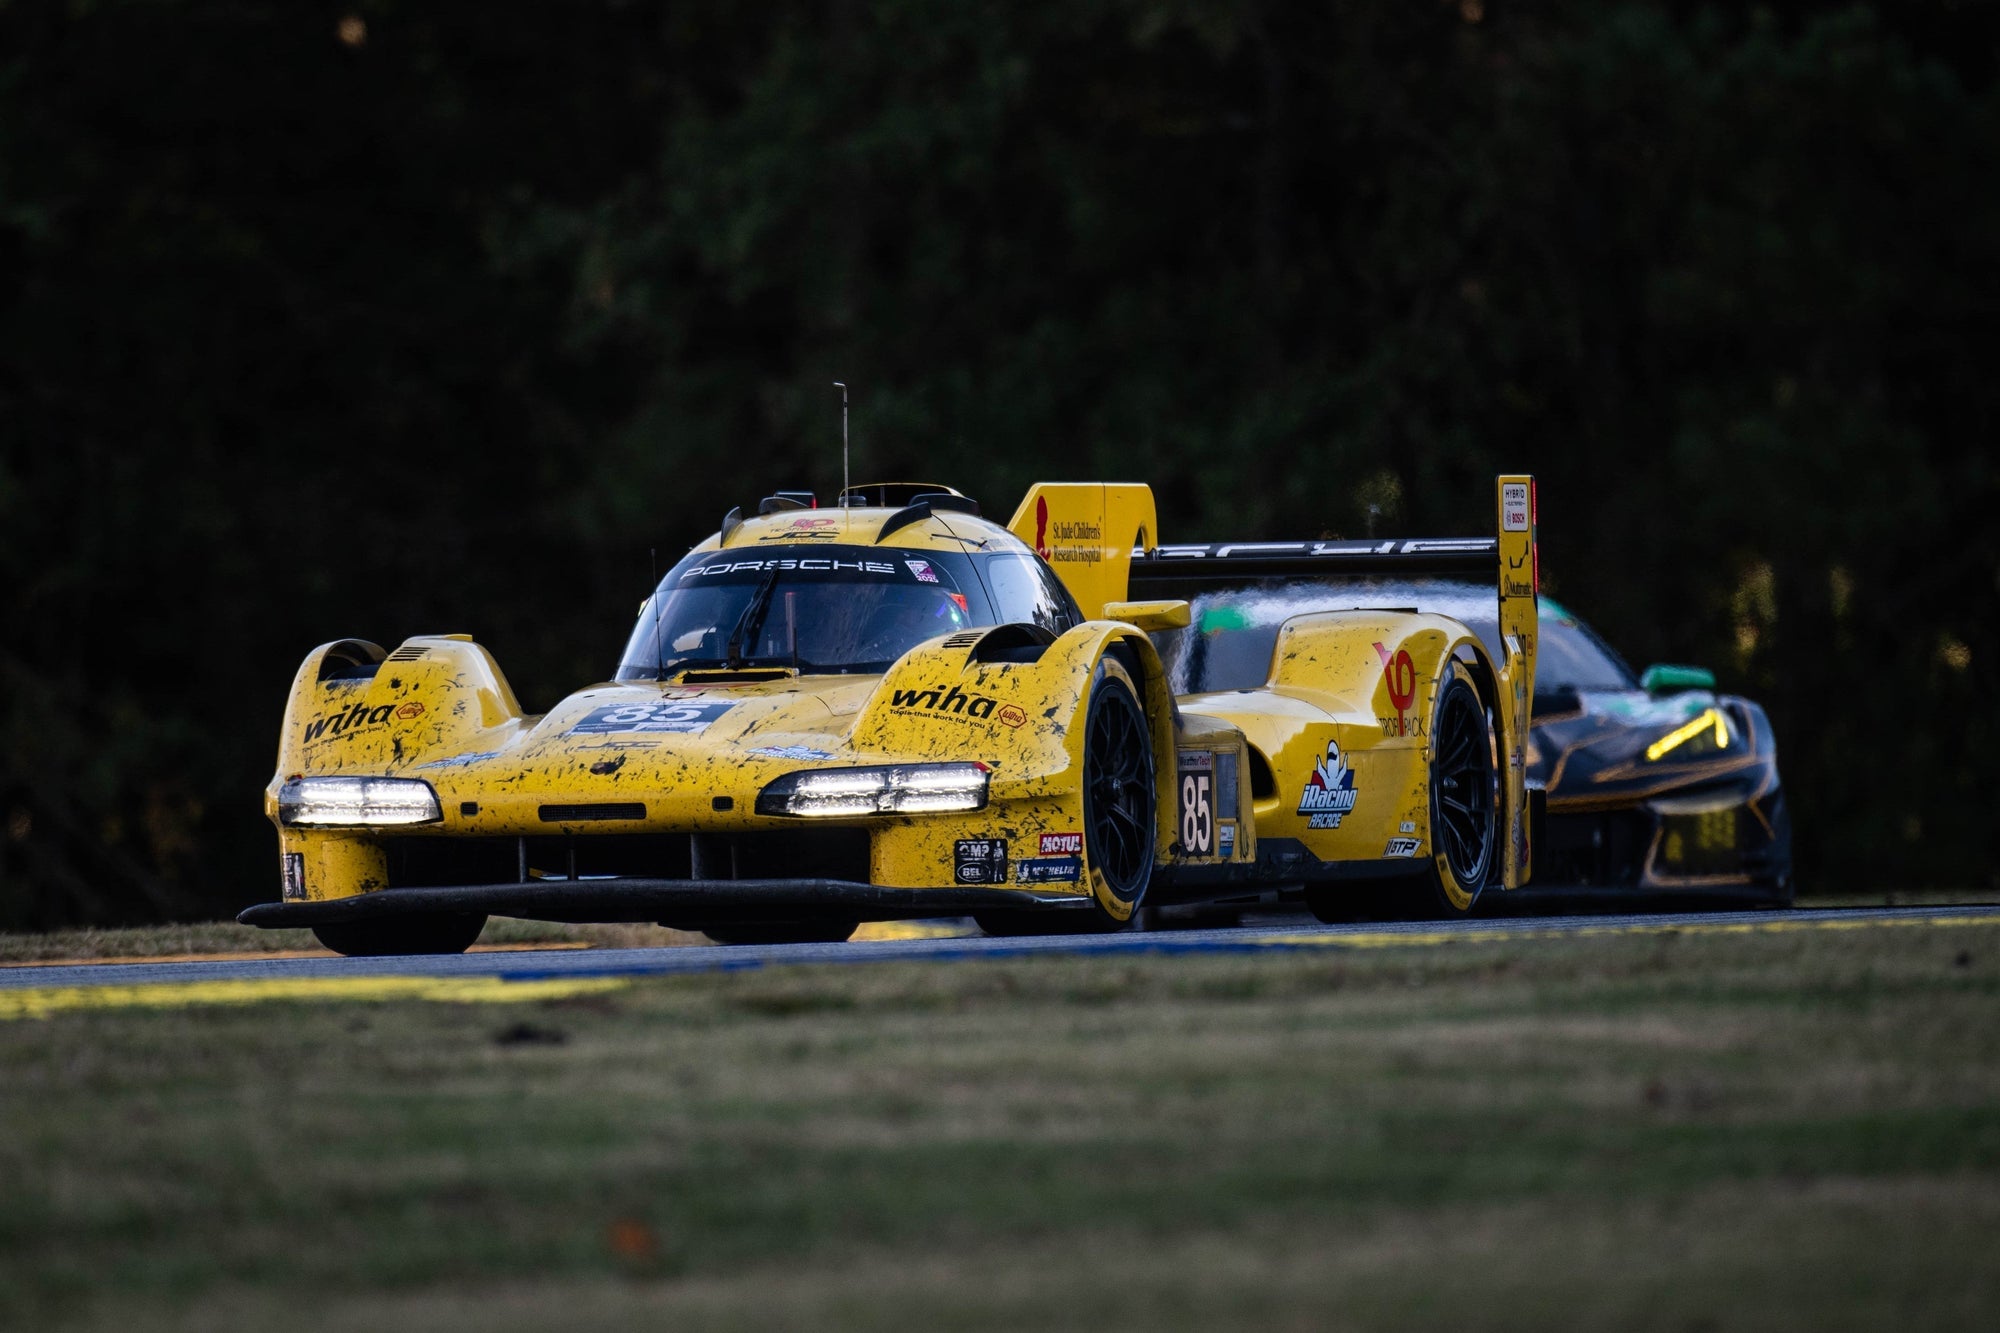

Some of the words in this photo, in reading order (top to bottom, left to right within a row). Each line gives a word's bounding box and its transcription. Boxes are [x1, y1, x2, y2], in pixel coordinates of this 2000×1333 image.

[1512, 513, 1525, 524] BOSCH
[1060, 522, 1073, 544] Jude
[1073, 521, 1101, 540] Children's
[1053, 544, 1078, 562] Research
[1079, 544, 1101, 568] Hospital
[680, 560, 895, 580] PORSCHE
[892, 684, 998, 719] wiha
[303, 702, 397, 744] wiha
[602, 705, 712, 723] 85
[955, 716, 967, 724] for
[969, 721, 985, 729] you
[1301, 784, 1358, 808] iRacing
[1183, 775, 1211, 852] 85
[1310, 813, 1342, 827] ARCADE
[1041, 835, 1081, 852] MOTUL
